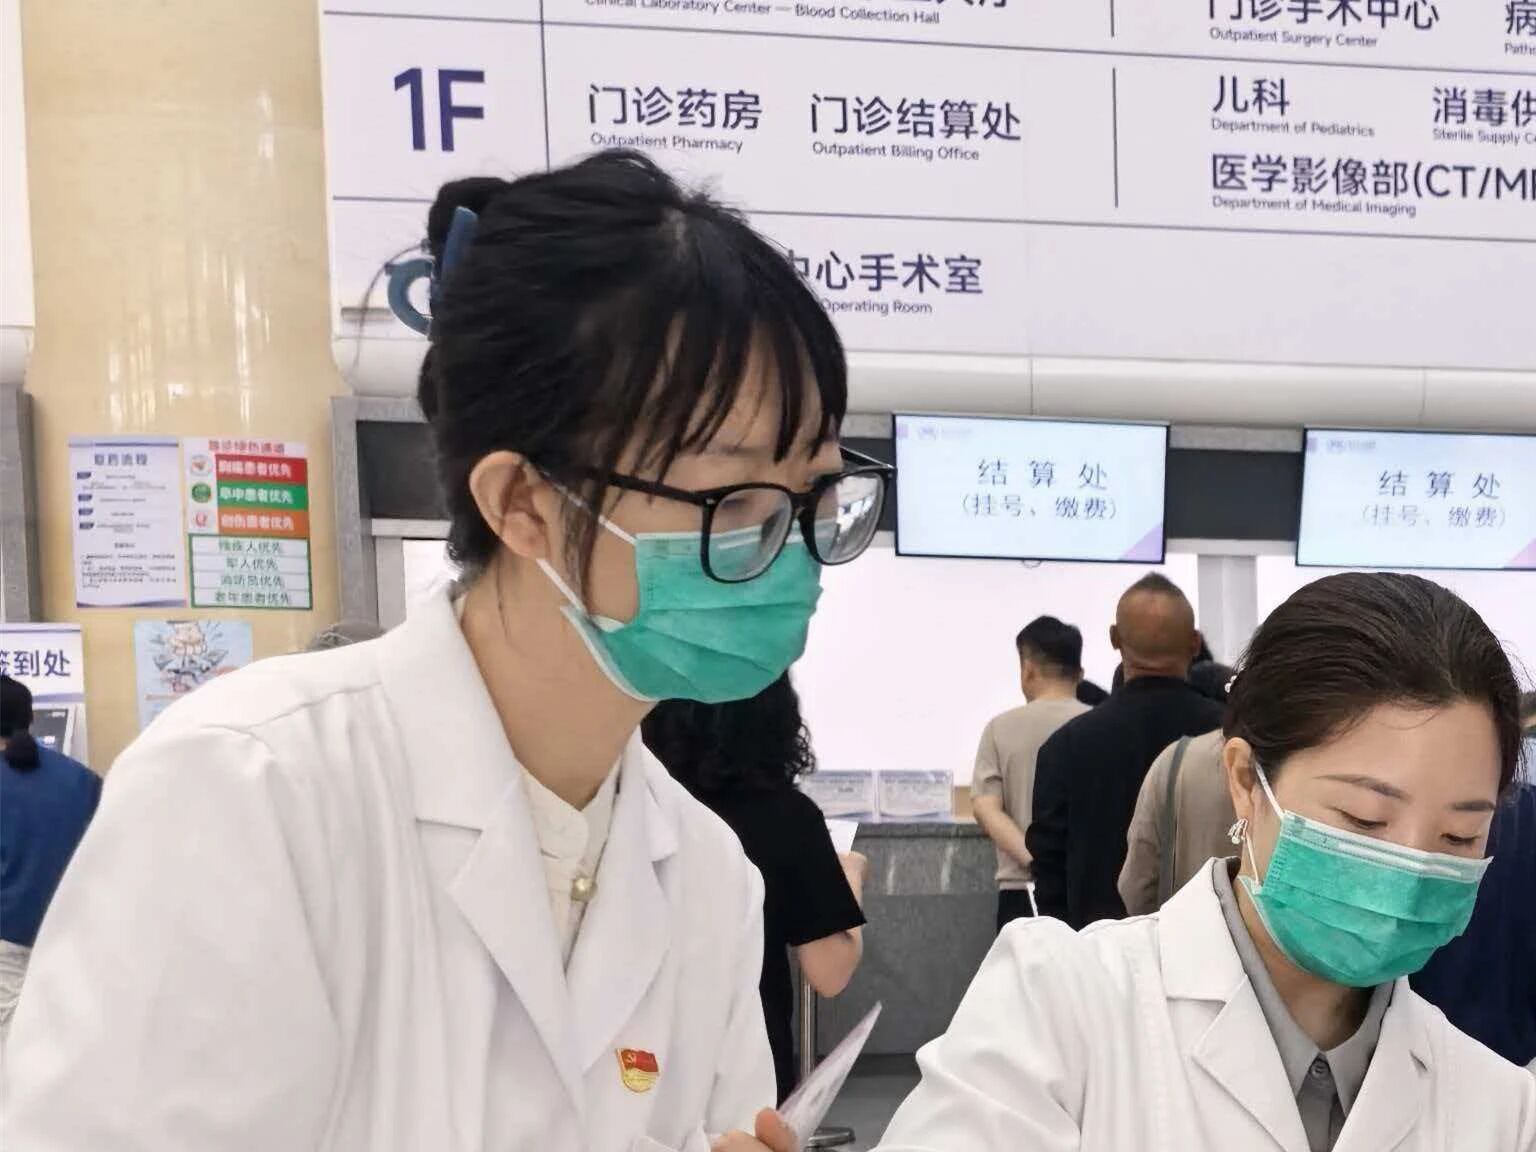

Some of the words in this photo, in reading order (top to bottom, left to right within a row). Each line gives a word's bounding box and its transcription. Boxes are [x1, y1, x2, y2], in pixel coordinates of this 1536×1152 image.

[724, 2, 771, 15] Center
[795, 4, 835, 18] Blood
[840, 6, 909, 22] Collection
[914, 9, 940, 24] Hall
[1210, 27, 1277, 42] Outpatient
[1282, 31, 1331, 47] Surgery
[1336, 33, 1378, 47] Center
[1213, 75, 1290, 116] 儿科
[394, 67, 485, 152] 1F
[589, 83, 762, 132] 门诊药房
[811, 93, 1021, 141] 门诊结算处
[1211, 118, 1290, 134] Department
[1294, 121, 1307, 133] of
[1312, 122, 1375, 137] Pediatrics
[1433, 128, 1473, 142] Sterile
[1478, 130, 1520, 147] Supply
[590, 132, 667, 149] Outpatient
[672, 136, 744, 154] Pharmacy
[812, 141, 887, 158] Outpatient
[891, 144, 933, 162] Billing
[938, 146, 980, 161] Office
[1212, 195, 1290, 211] Department
[1295, 199, 1308, 210] of
[1312, 200, 1362, 213] Medical
[1366, 202, 1416, 218] Imaging
[820, 298, 889, 316] Operating
[893, 301, 933, 314] Room
[977, 456, 1108, 491] 结算处
[1378, 469, 1501, 500] 结算处
